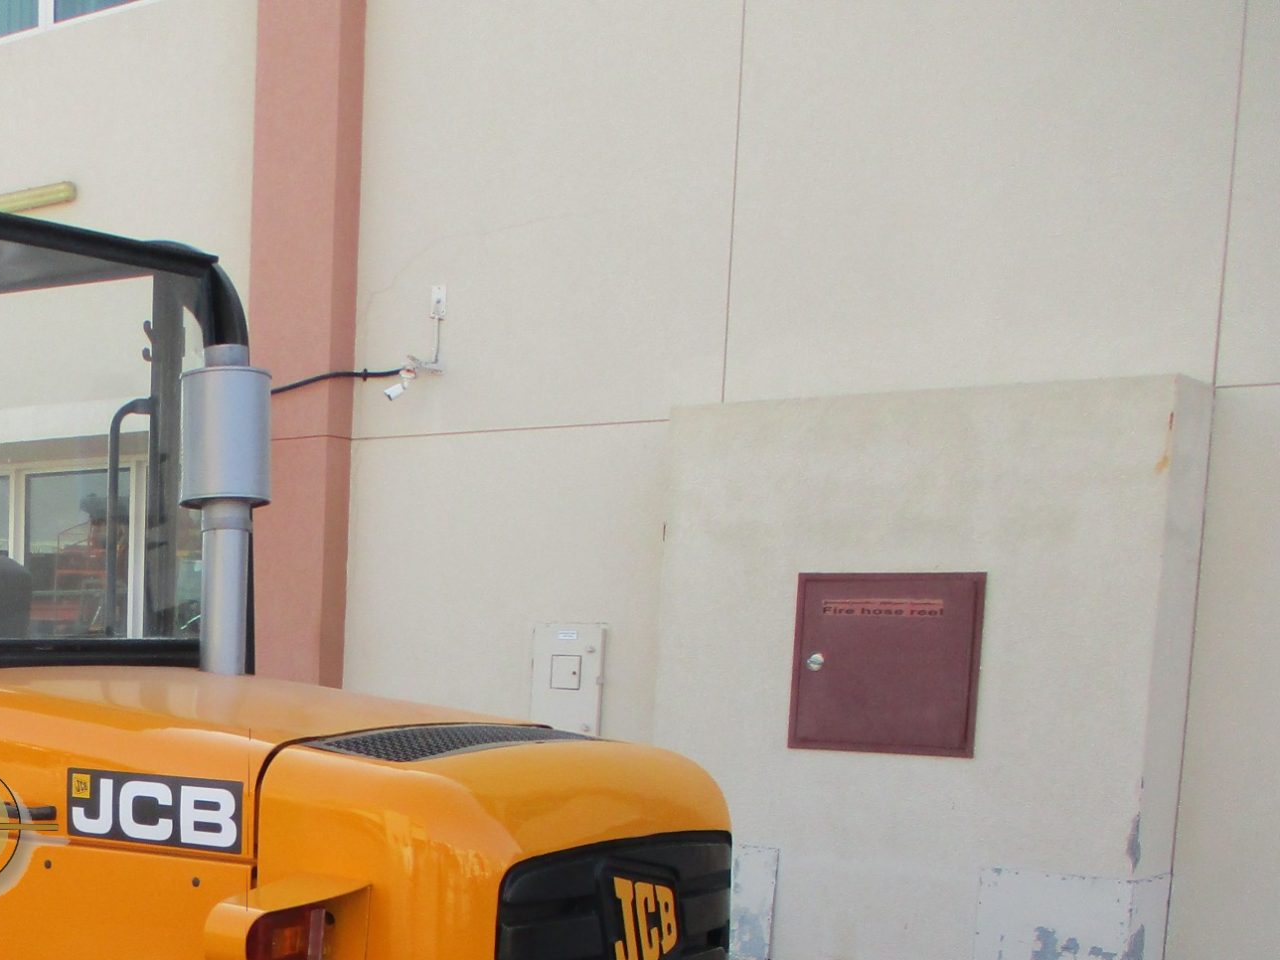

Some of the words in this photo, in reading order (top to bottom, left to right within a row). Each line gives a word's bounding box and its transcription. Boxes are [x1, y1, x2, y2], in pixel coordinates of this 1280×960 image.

[823, 607, 855, 615] Fire
[861, 607, 904, 616] hose
[910, 608, 944, 616] reel
[72, 778, 238, 848] JCB
